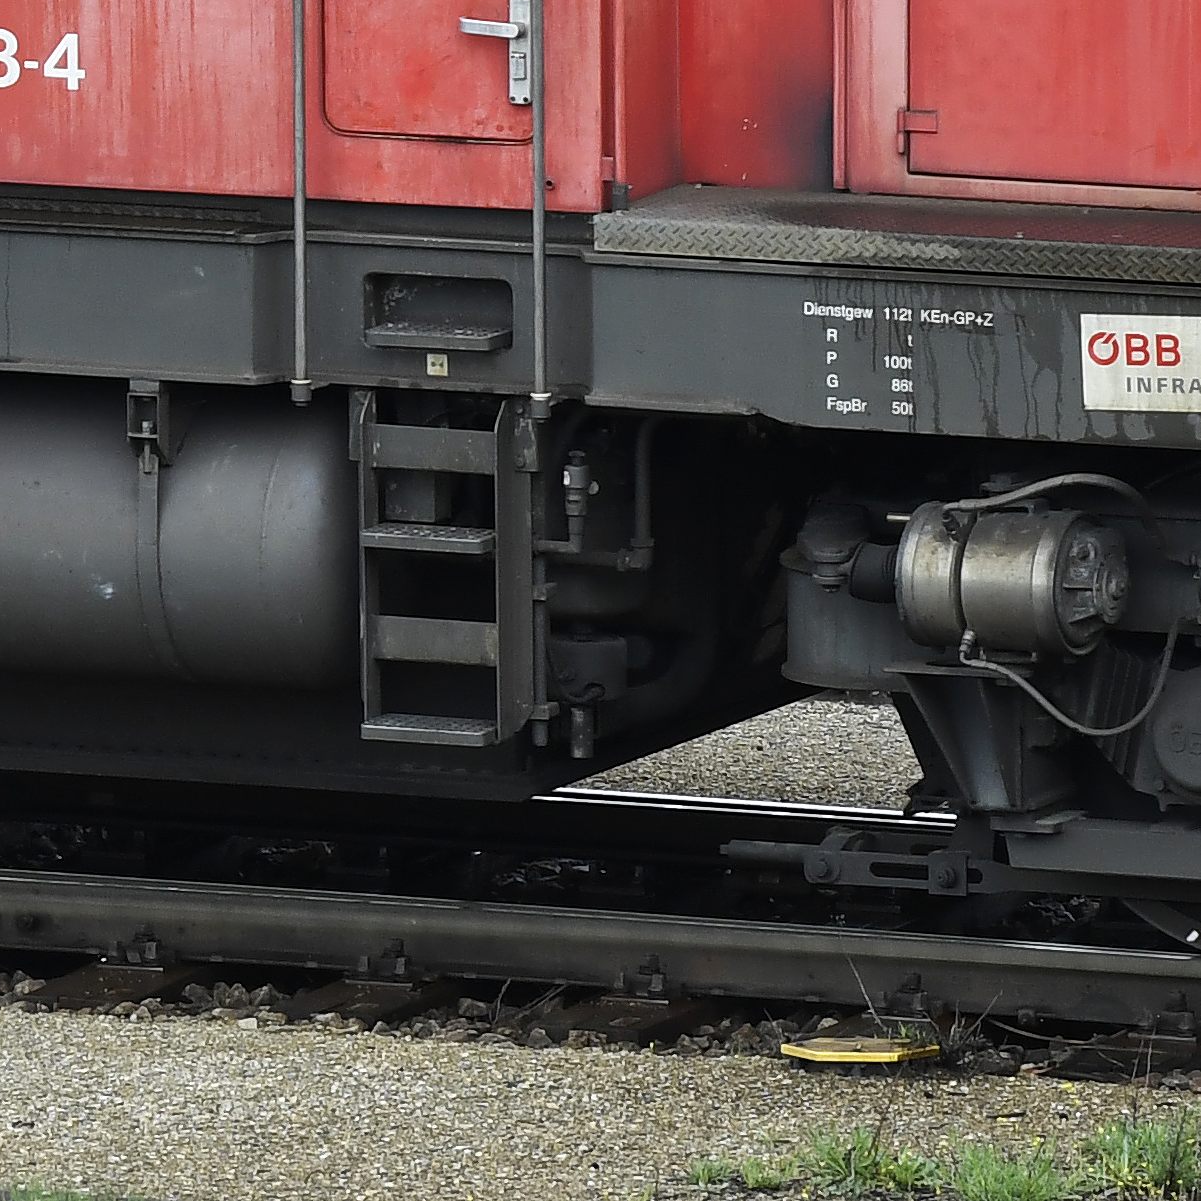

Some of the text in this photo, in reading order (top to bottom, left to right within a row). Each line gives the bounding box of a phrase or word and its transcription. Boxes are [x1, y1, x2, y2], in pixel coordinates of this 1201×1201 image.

[803, 301, 994, 327] Dienstgew 112t KEn-GP+Z
[826, 328, 838, 342] R
[1088, 331, 1181, 366] ÖBB
[826, 351, 912, 369] P 100t
[826, 374, 913, 392] G 86t
[1126, 376, 1201, 393] INFRA
[826, 397, 913, 415] FspBr 50t
